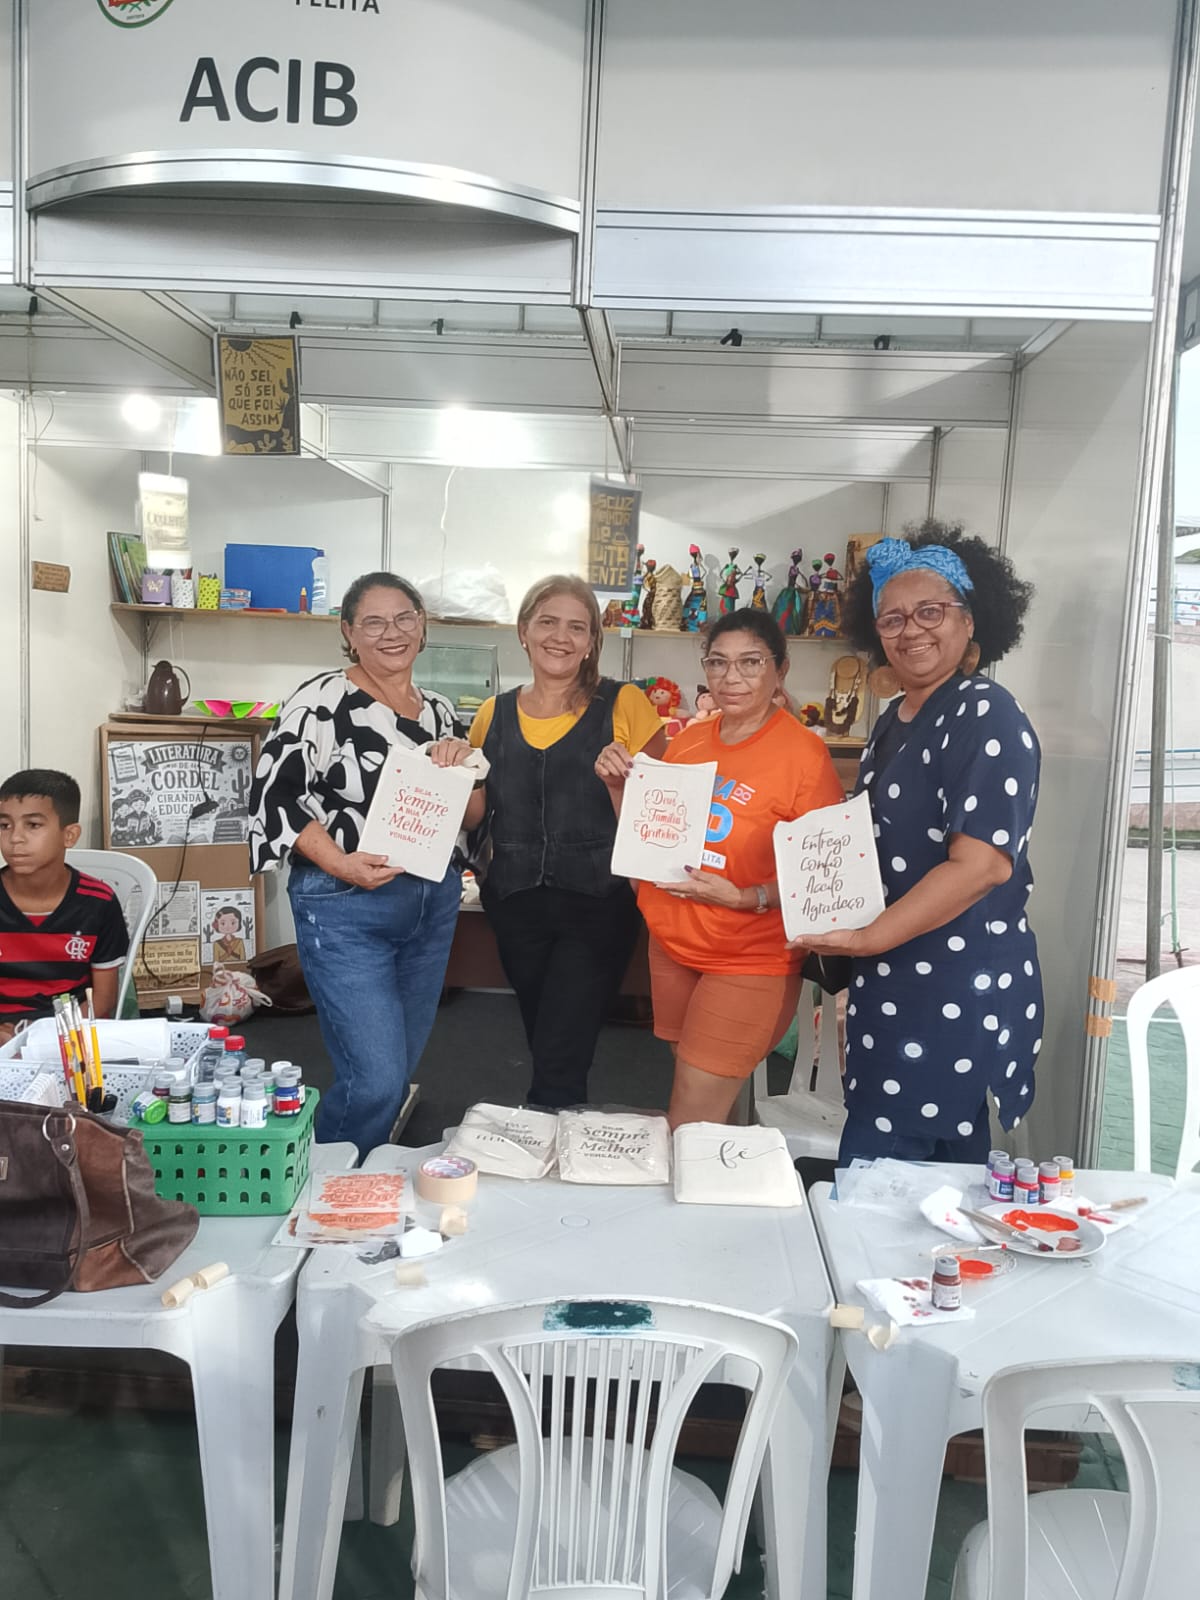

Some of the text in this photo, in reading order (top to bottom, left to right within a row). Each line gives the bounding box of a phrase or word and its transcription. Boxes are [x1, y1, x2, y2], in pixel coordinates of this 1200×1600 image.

[179, 56, 359, 127] ACIB
[225, 367, 245, 381] NÃO
[235, 382, 276, 397] SÓ SEI
[228, 398, 273, 411] QUE FOI
[241, 413, 280, 425] ASSIM
[148, 744, 219, 765] LITERATURA
[151, 770, 220, 791] CORDEL
[157, 793, 202, 803] CIRANDA
[395, 788, 449, 816] Sempre
[388, 813, 439, 838] Melhor
[801, 827, 851, 855] Entrego
[800, 850, 842, 877] Confio
[802, 895, 865, 922] Agradeço
[582, 1127, 650, 1142] Sempre
[580, 1142, 646, 1154] Melhor
